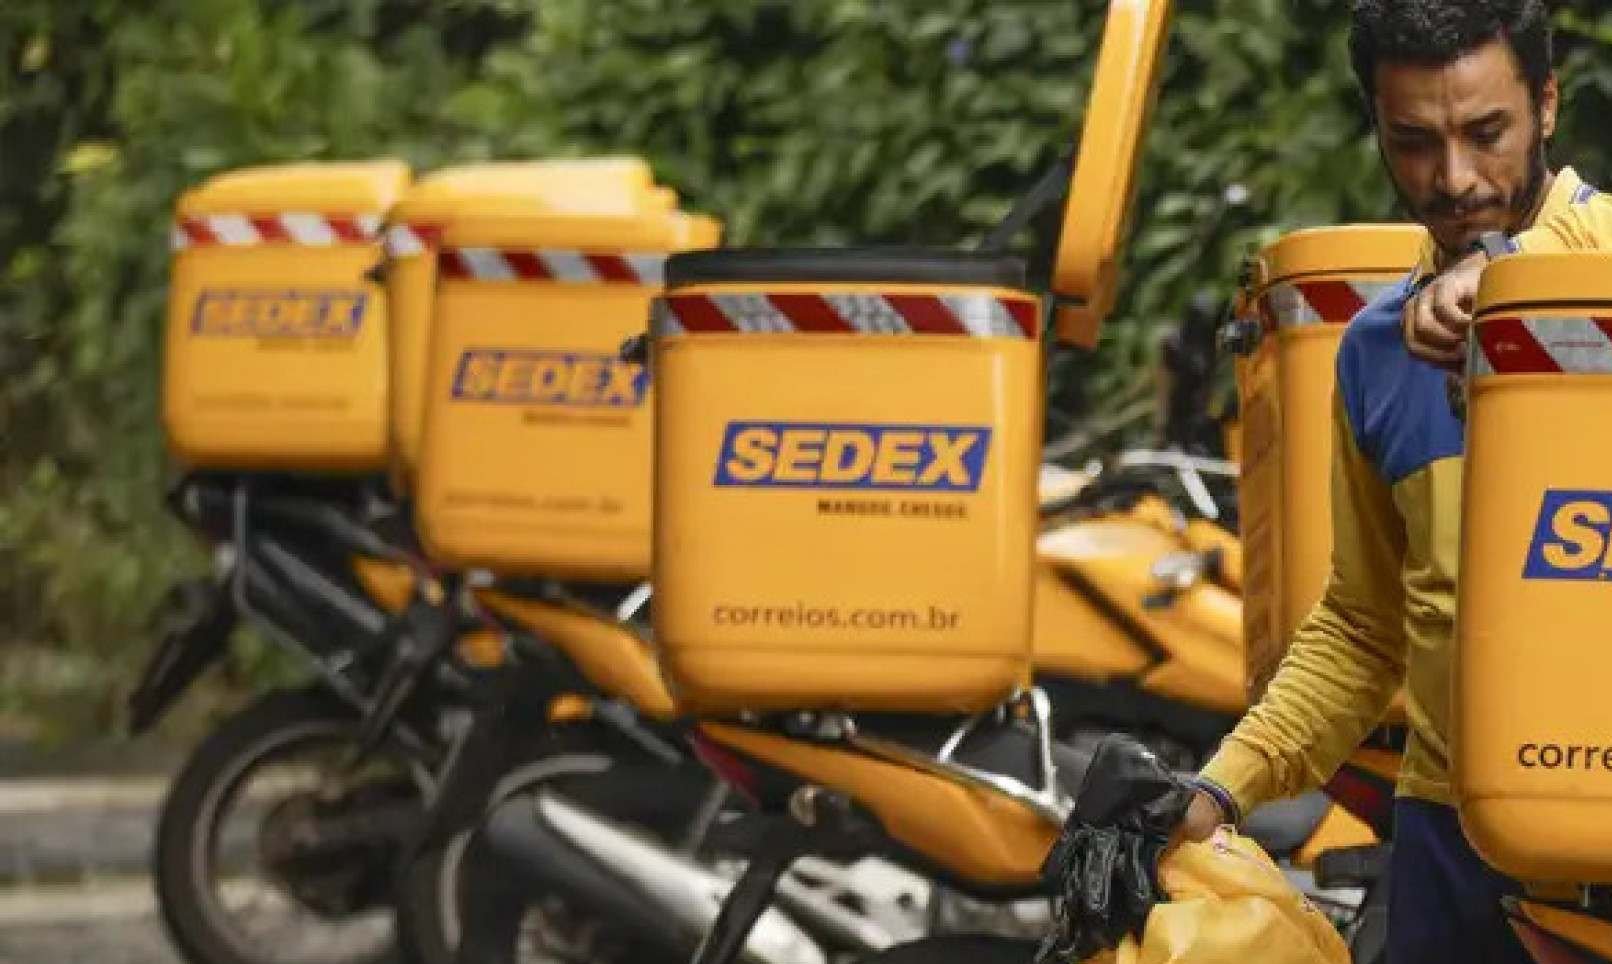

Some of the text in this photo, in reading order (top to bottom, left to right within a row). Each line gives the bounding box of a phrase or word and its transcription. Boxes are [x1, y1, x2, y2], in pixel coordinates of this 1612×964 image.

[464, 357, 644, 402] SEDEX
[726, 429, 977, 486] SEDEX
[713, 601, 961, 629] correios.com.br
